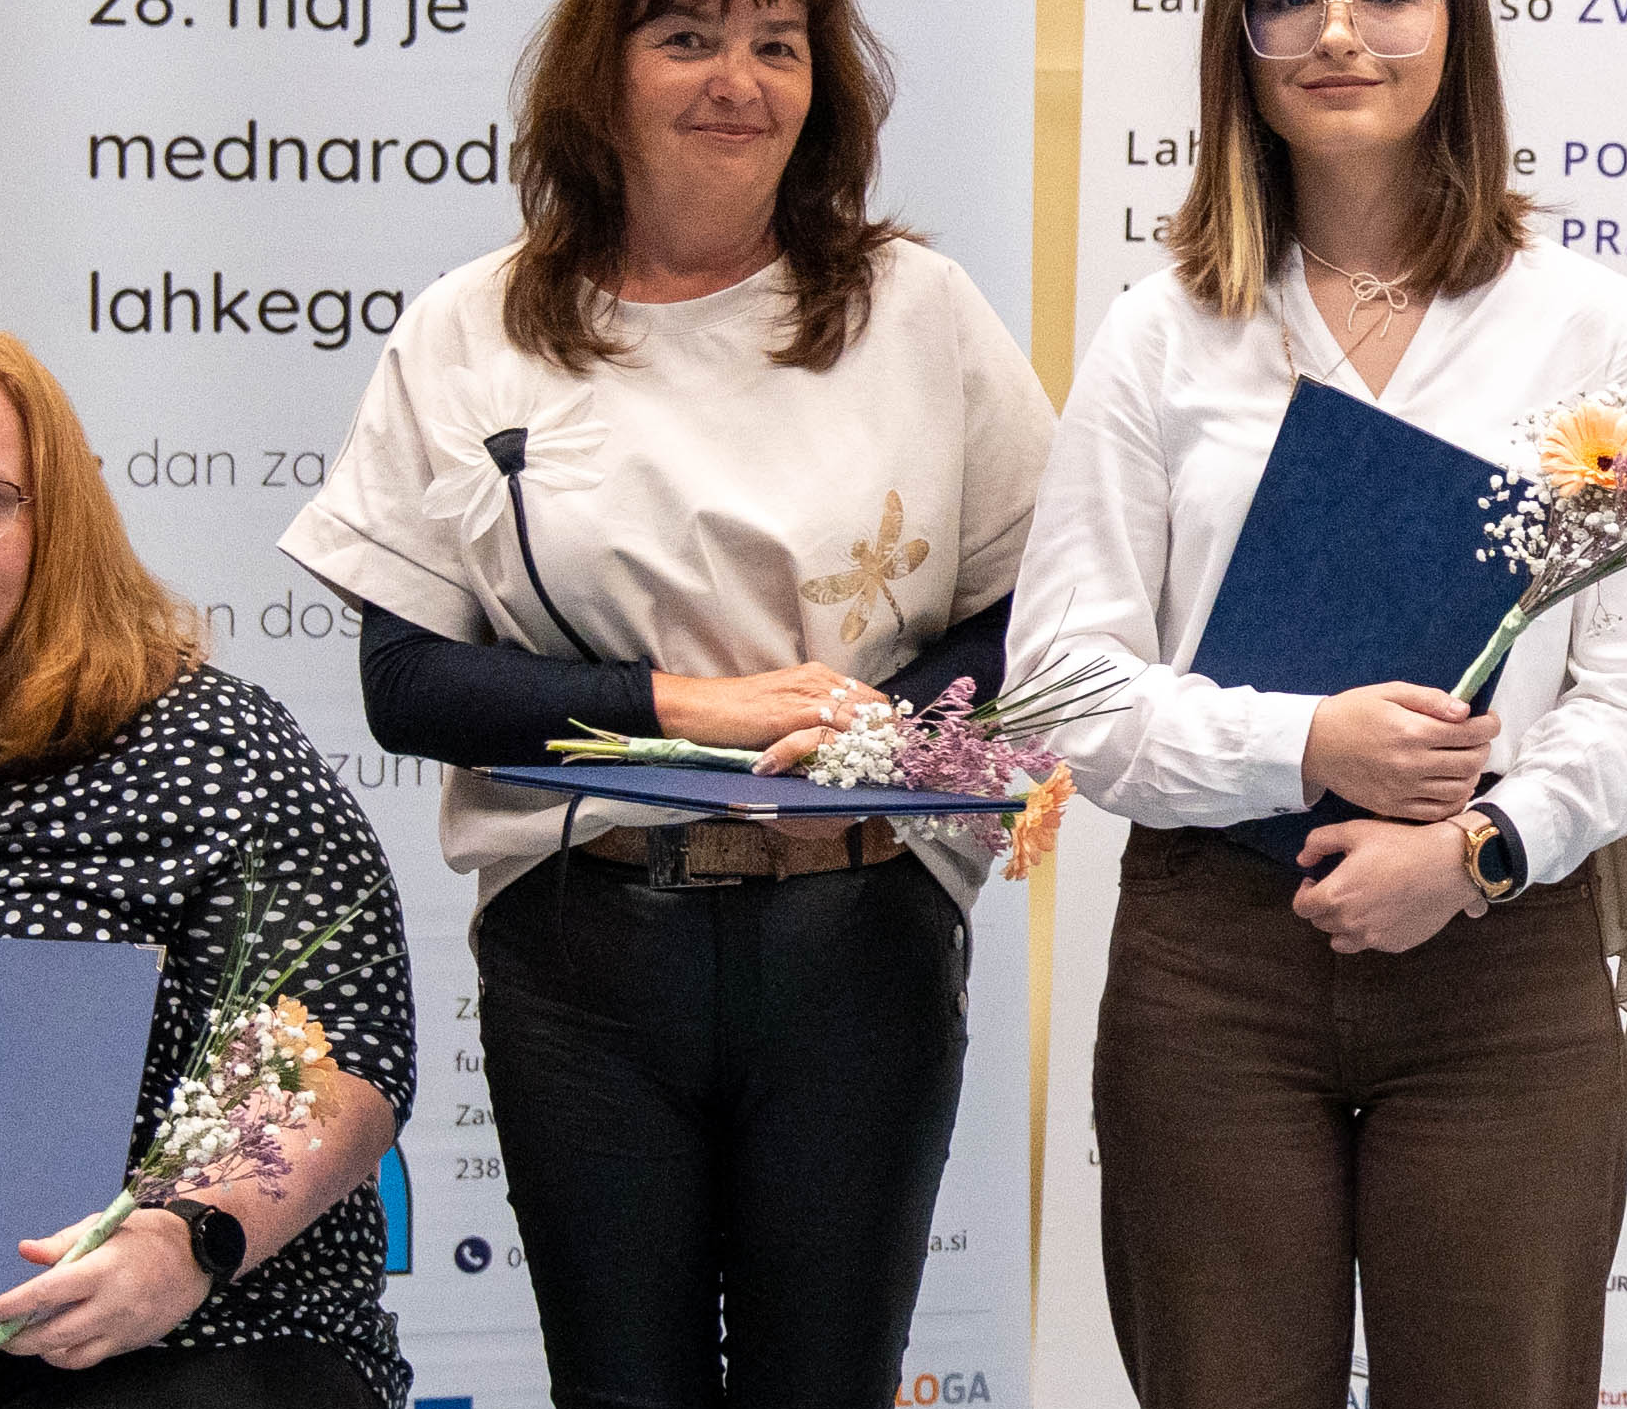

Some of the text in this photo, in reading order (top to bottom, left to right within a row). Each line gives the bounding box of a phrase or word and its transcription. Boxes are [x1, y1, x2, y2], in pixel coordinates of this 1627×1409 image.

[89, 119, 519, 185] mednarod
[90, 271, 406, 351] lahkega
[127, 438, 326, 488] dan za
[260, 591, 363, 640] dos
[894, 1372, 992, 1408] LOGA
